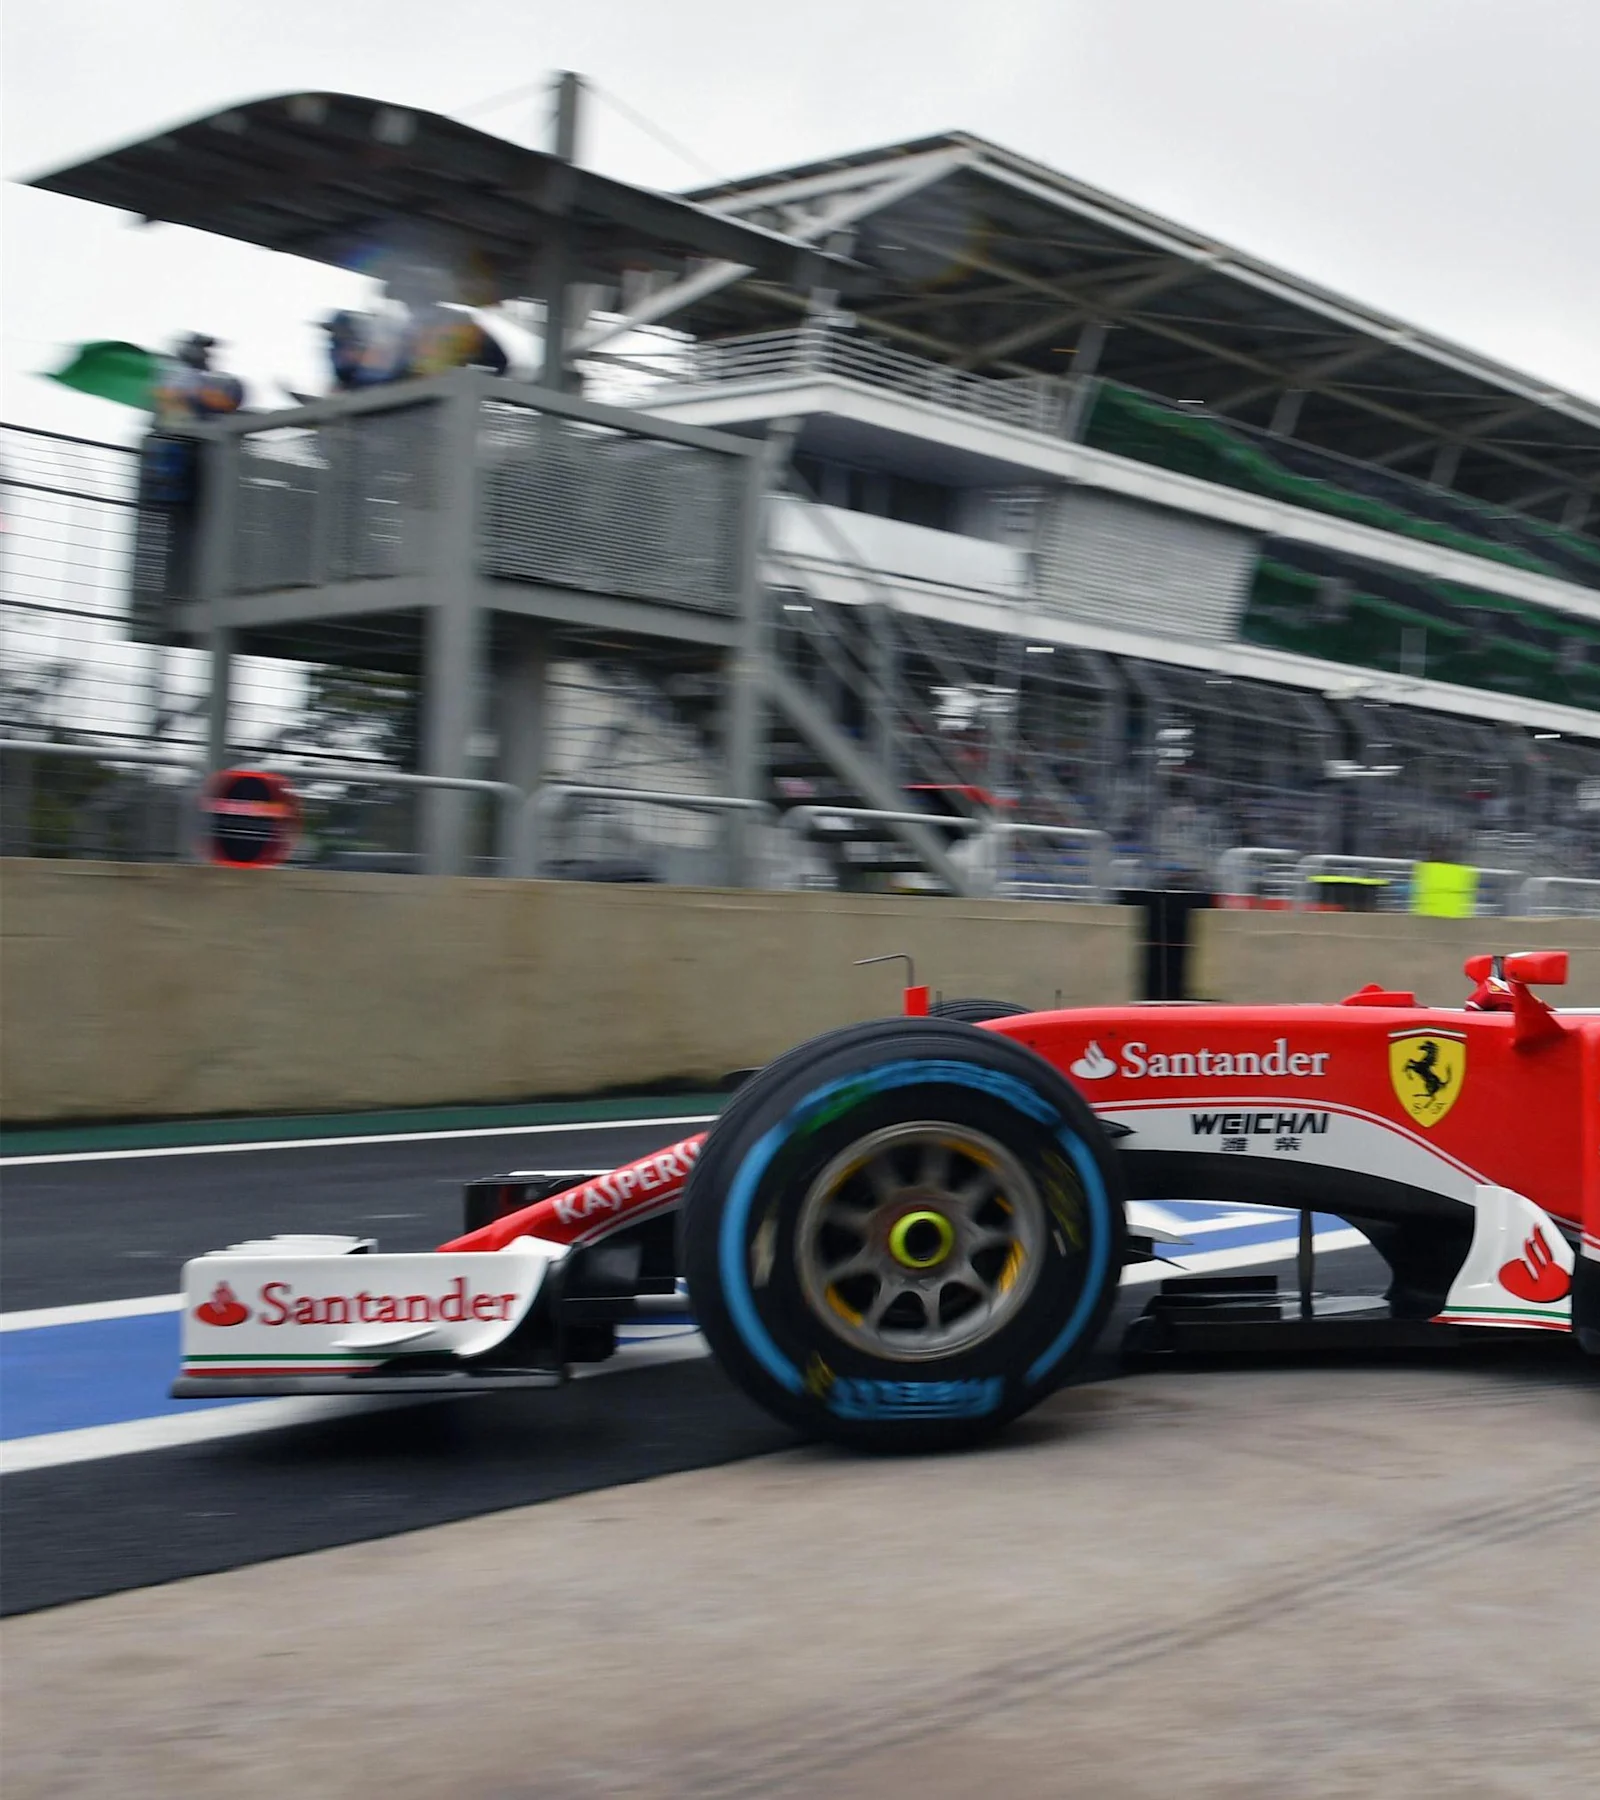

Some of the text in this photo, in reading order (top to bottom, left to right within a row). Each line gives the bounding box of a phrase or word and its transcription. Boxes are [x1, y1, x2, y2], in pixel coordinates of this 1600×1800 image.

[1121, 1037, 1330, 1079] Santander
[1190, 1113, 1331, 1135] WEICHAI
[259, 1276, 518, 1326] Santander
